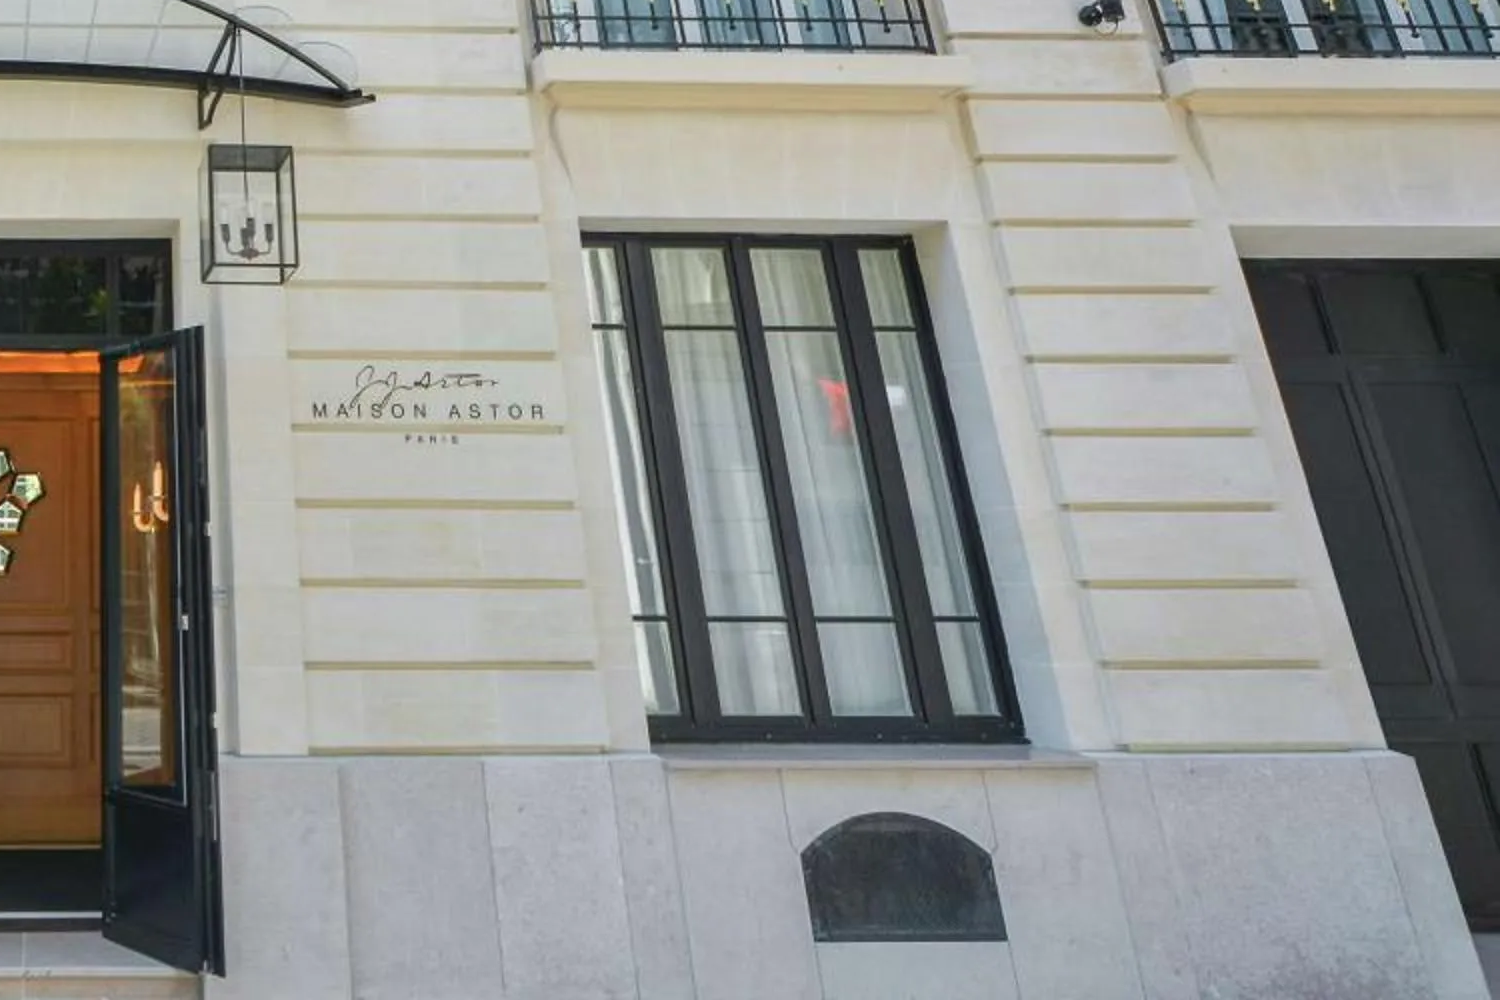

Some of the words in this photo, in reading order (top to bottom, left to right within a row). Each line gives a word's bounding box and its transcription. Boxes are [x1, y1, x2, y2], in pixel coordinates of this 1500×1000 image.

[312, 403, 427, 419] MAISON
[449, 403, 544, 419] ASTOR
[405, 434, 459, 445] PARIS
